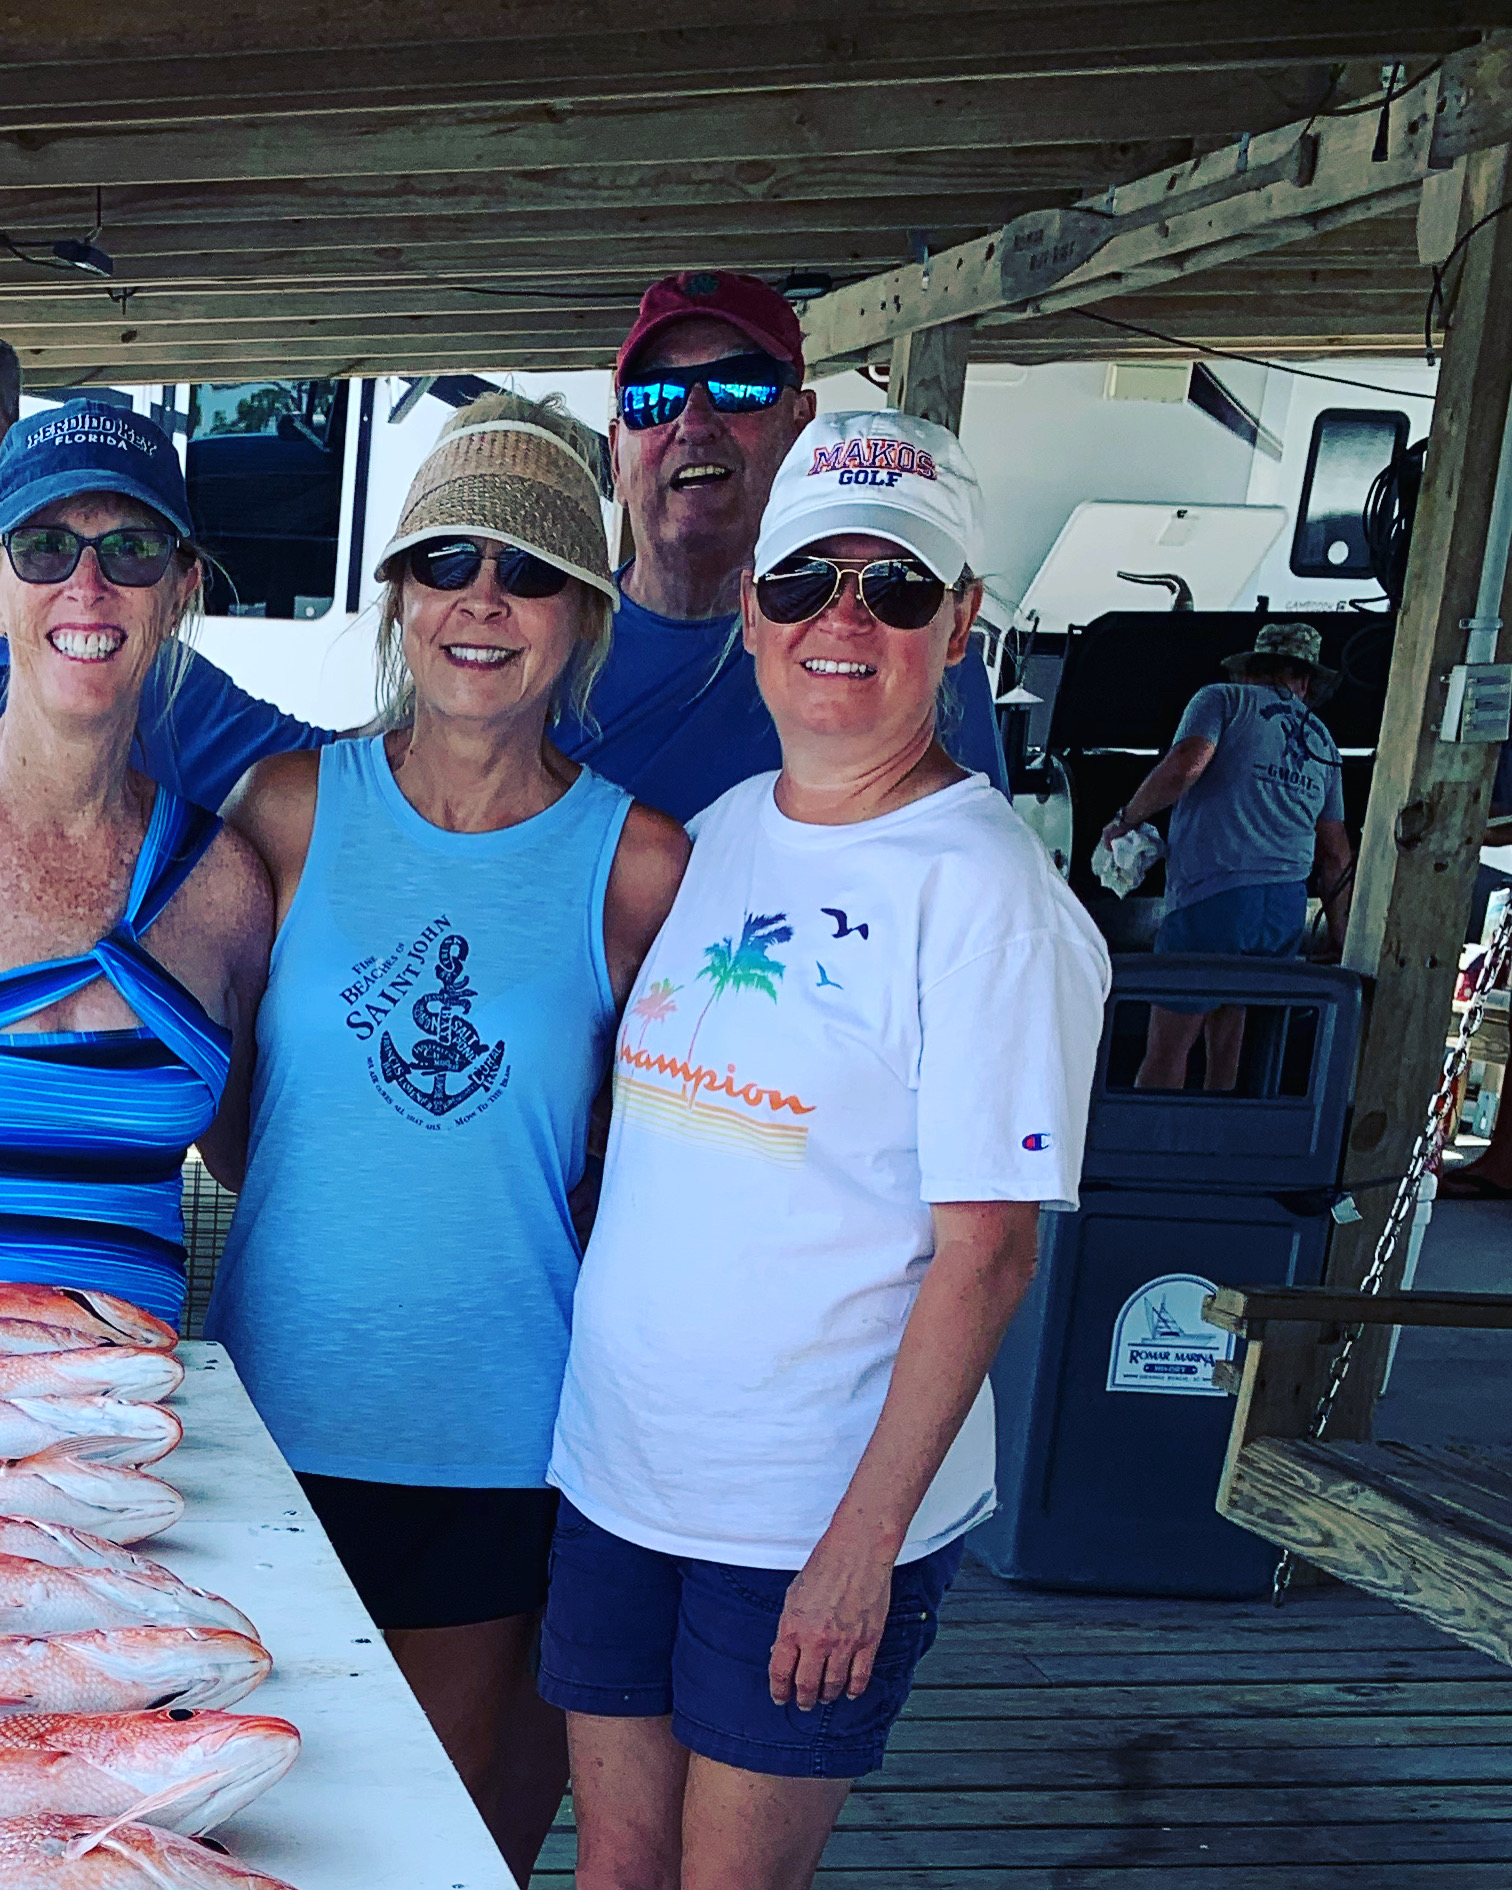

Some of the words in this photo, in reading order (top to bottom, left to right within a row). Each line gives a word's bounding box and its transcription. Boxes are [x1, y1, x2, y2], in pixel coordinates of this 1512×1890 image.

[27, 414, 115, 450] PERDIDO
[118, 420, 158, 456] KEY
[55, 434, 128, 451] FLORIDA
[807, 438, 938, 480] MAKOS
[839, 470, 903, 487] GOLF
[339, 955, 399, 1006] BEACHES
[346, 963, 421, 1040] SAINT
[407, 914, 453, 965] JOHN
[452, 1020, 478, 1045] SALT
[620, 1044, 817, 1115] hampion
[1129, 1349, 1171, 1364] ROMAR
[1174, 1352, 1216, 1367] MARINA
